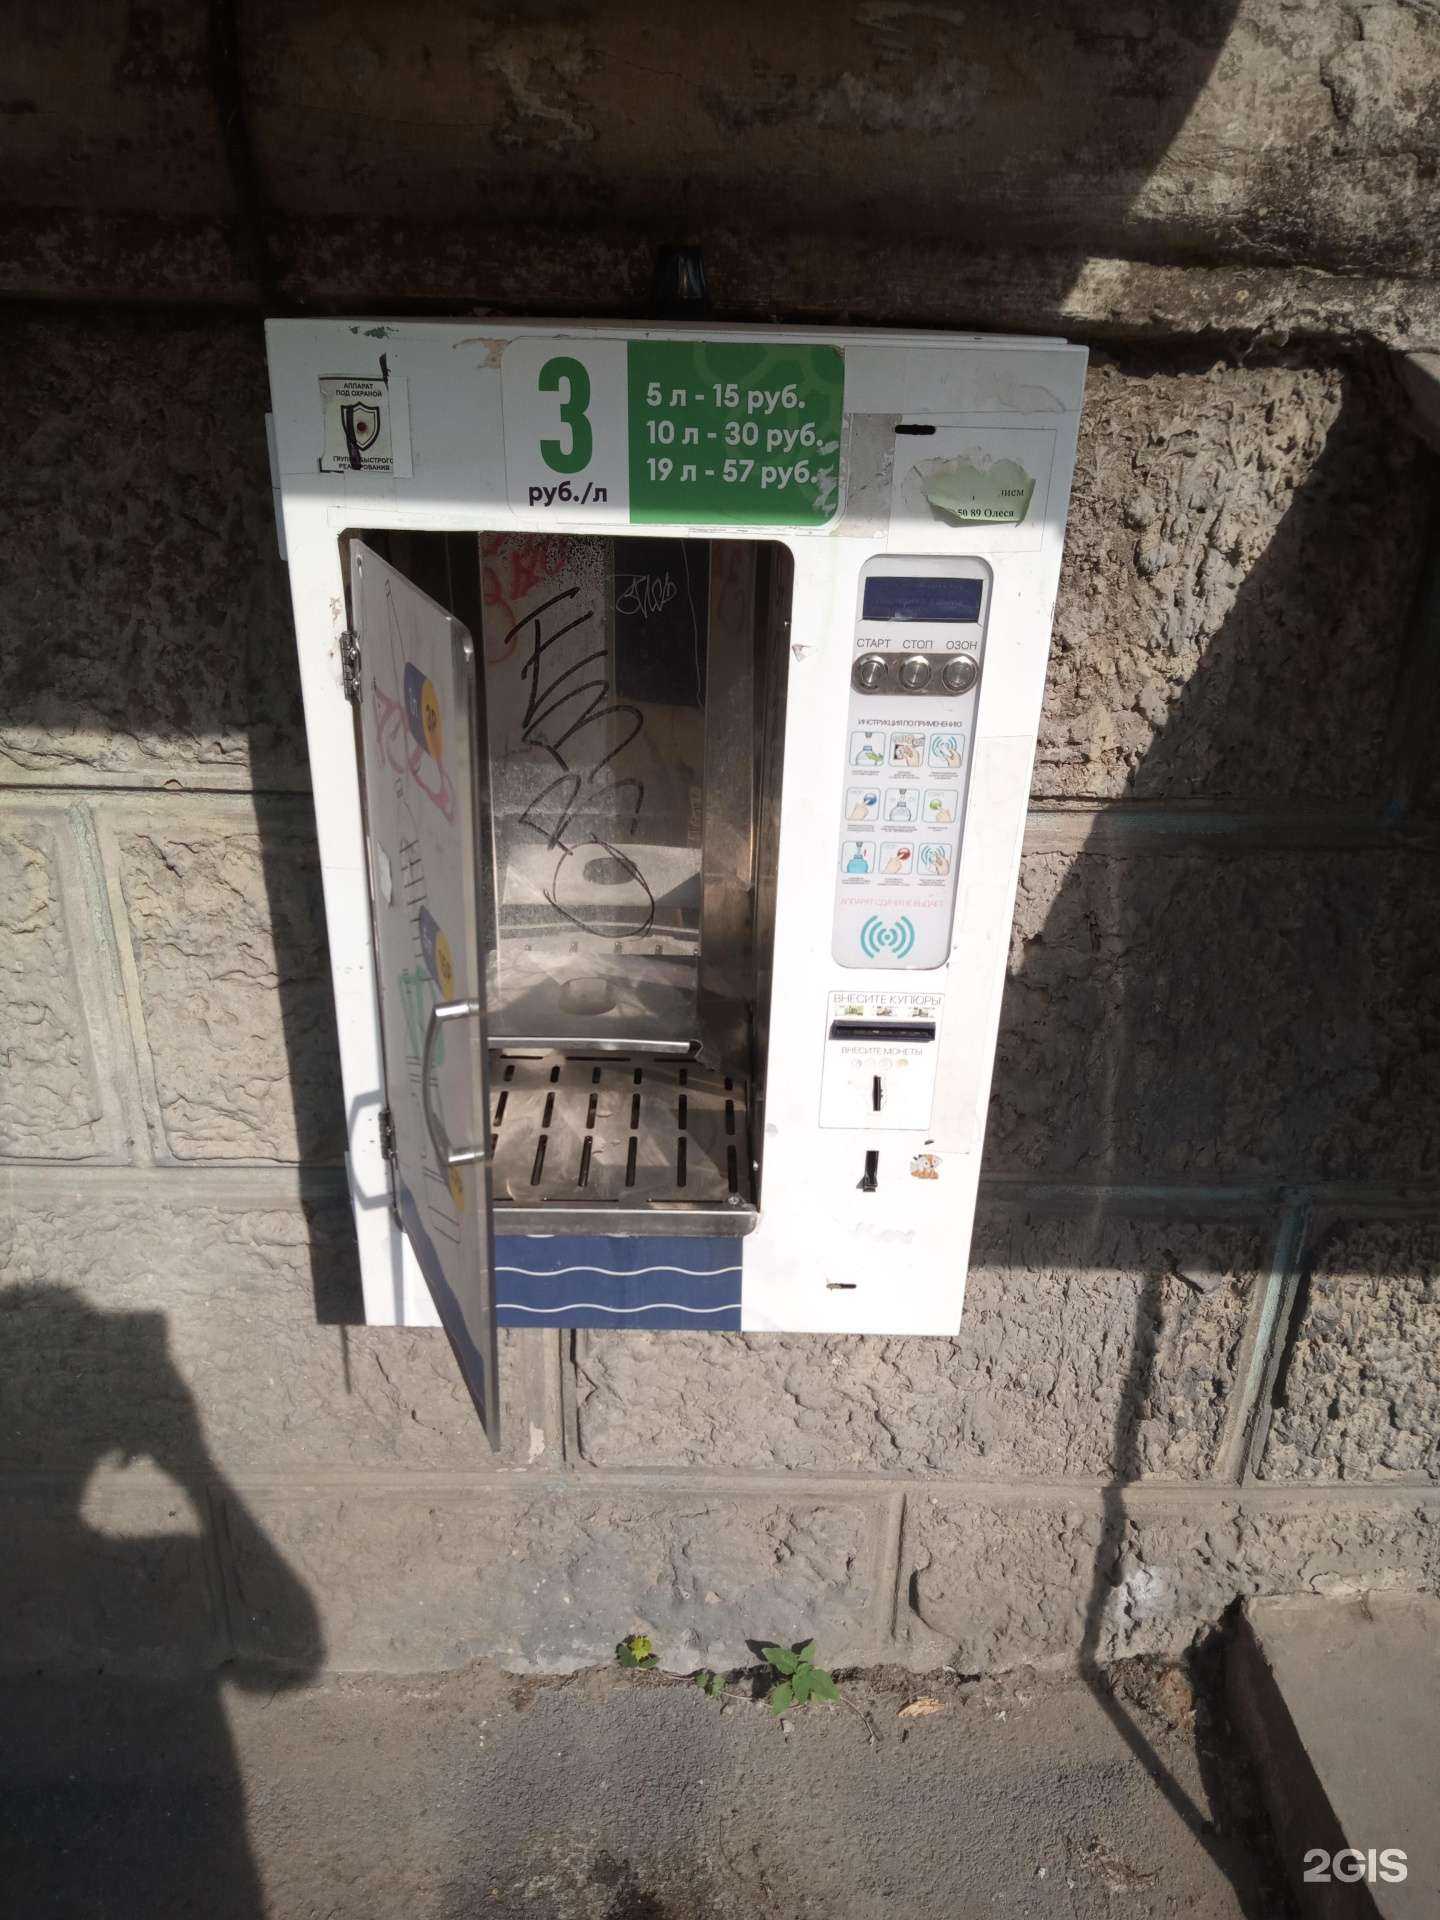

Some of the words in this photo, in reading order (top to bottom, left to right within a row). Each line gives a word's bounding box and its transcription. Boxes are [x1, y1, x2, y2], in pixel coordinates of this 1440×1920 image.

[336, 389, 351, 397] ПОД
[351, 389, 382, 398] ОХРАНОЙ
[646, 382, 662, 407] 5
[669, 389, 688, 407] л
[712, 383, 740, 408] 15
[747, 383, 806, 414] руб.
[538, 356, 593, 474] 3
[646, 420, 675, 445] 10
[682, 427, 699, 445] л
[725, 421, 759, 446] 30
[767, 422, 824, 453] руб.
[333, 455, 359, 463] ГРУП
[339, 463, 390, 471] РЕАРОВАНИЯ
[646, 457, 674, 482] 19
[680, 464, 697, 482] л
[723, 459, 755, 483] 57
[761, 459, 818, 490] руб.
[528, 480, 608, 507] руб./л
[970, 508, 981, 518] 89
[984, 508, 1014, 518] Олеся
[856, 638, 891, 649] СТАРТ
[902, 639, 933, 649] СТОП
[945, 640, 978, 650] ОЗОН
[833, 993, 886, 1004] ВНЕСИТЕ
[889, 995, 941, 1006] КУПЮРЫ
